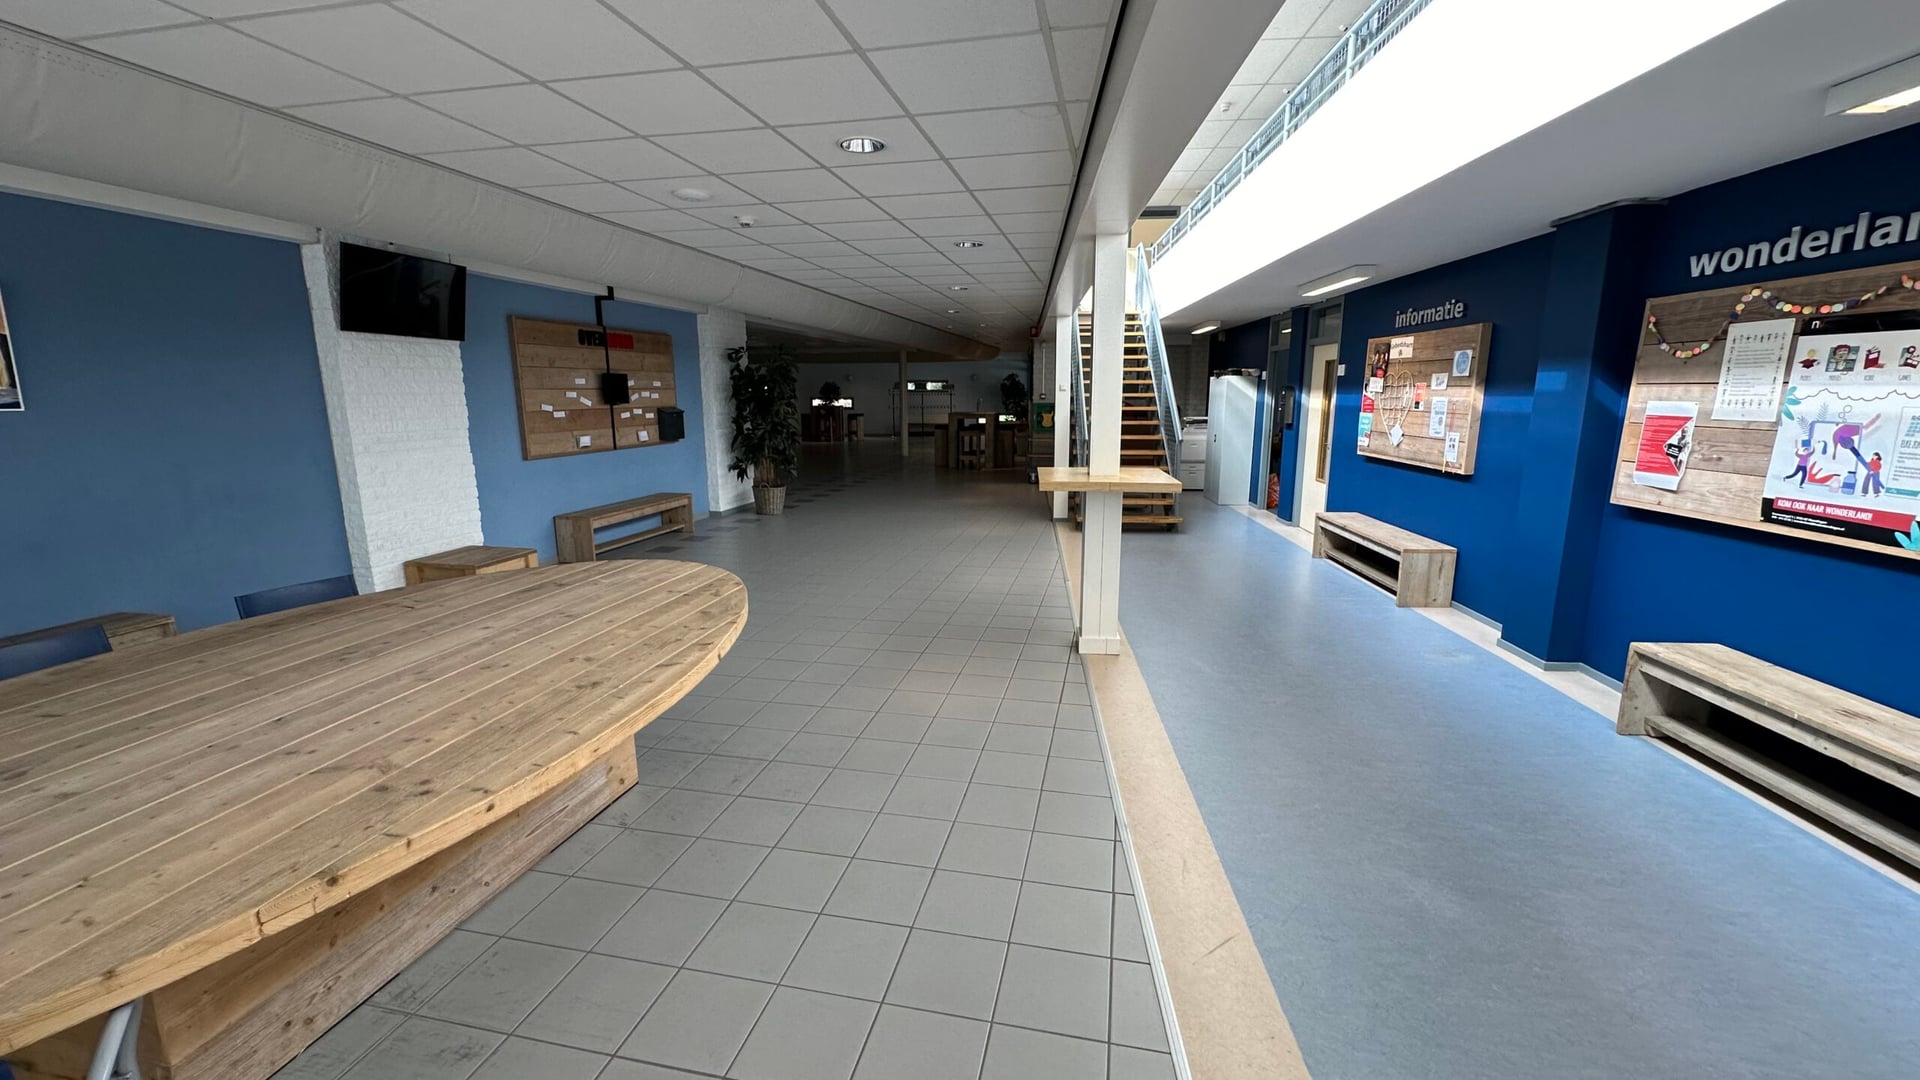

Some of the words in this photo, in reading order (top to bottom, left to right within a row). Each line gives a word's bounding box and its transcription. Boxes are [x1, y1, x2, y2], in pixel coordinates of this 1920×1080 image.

[1395, 299, 1464, 328] informatie
[1777, 499, 1792, 507] KOM
[1792, 501, 1807, 510] OOK
[1807, 504, 1825, 513] NAAR
[1825, 506, 1873, 521] WONDERLAND!
